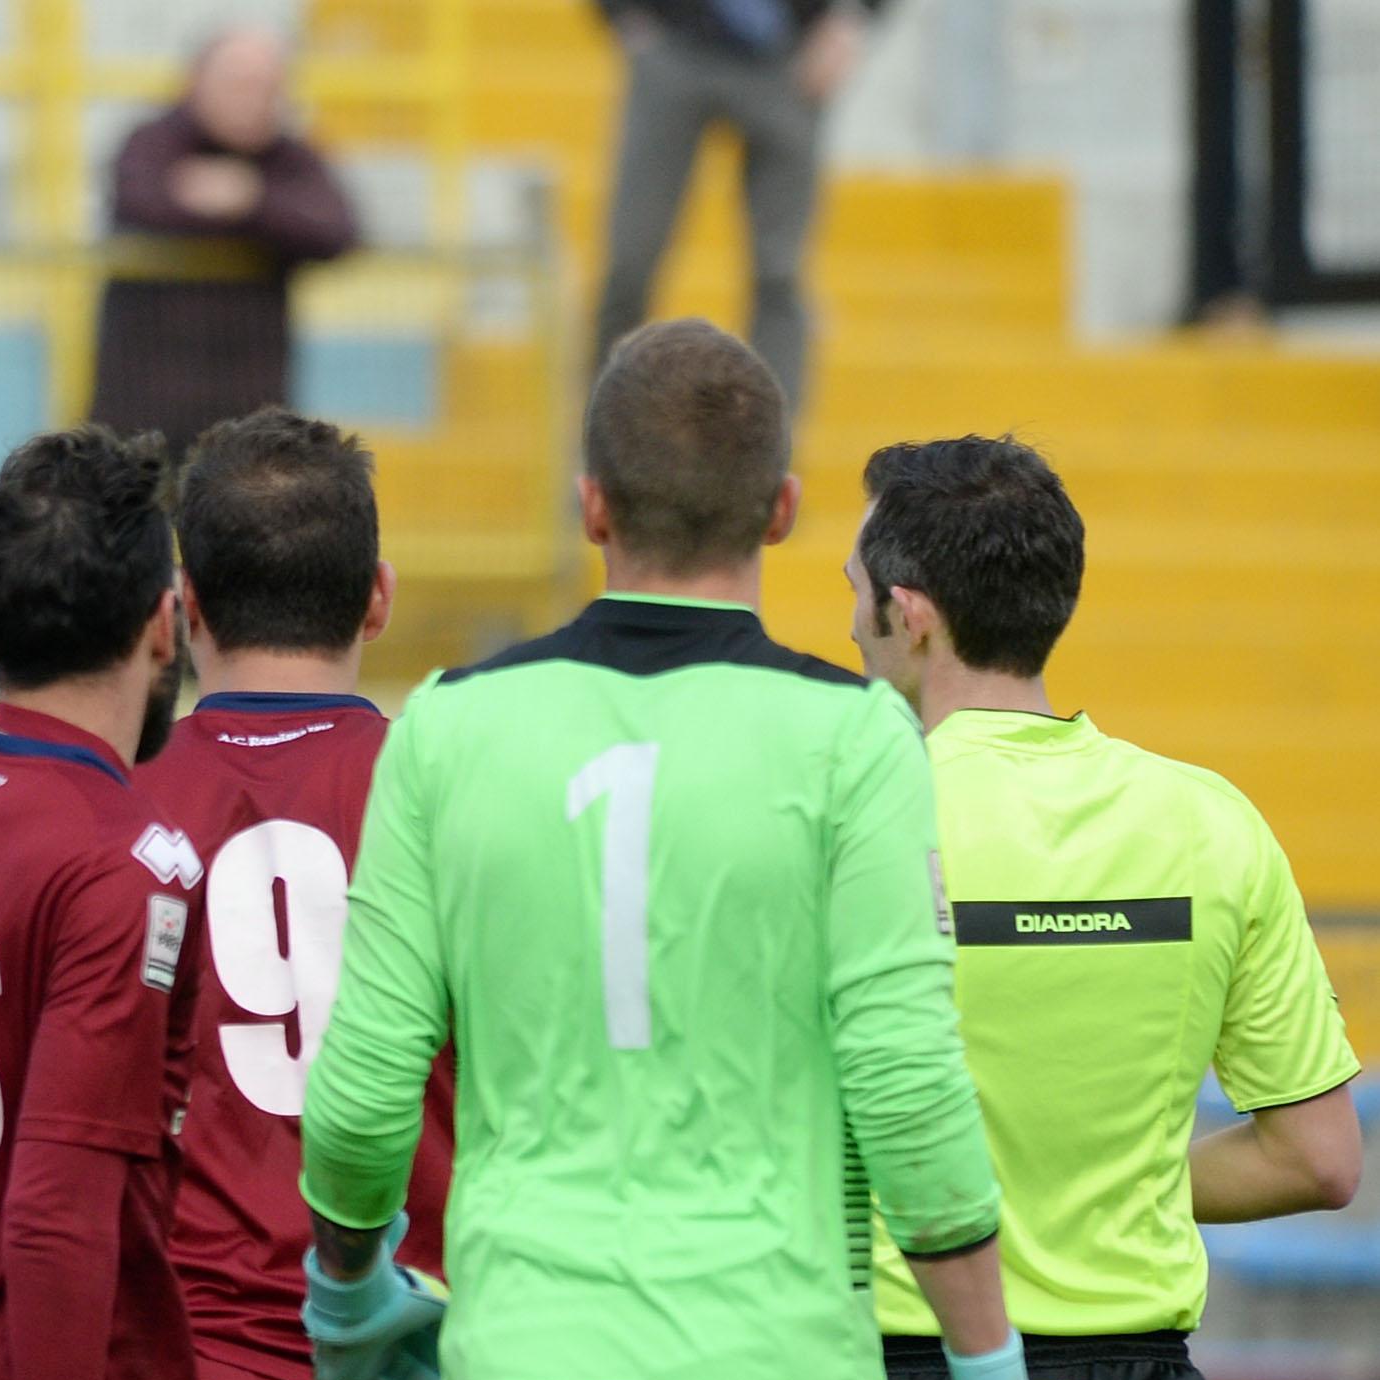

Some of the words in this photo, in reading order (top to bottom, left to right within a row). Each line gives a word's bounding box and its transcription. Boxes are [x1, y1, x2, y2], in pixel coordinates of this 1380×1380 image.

[206, 818, 349, 1117] 9
[566, 743, 658, 1050] 1
[1015, 912, 1133, 933] DIADORA
